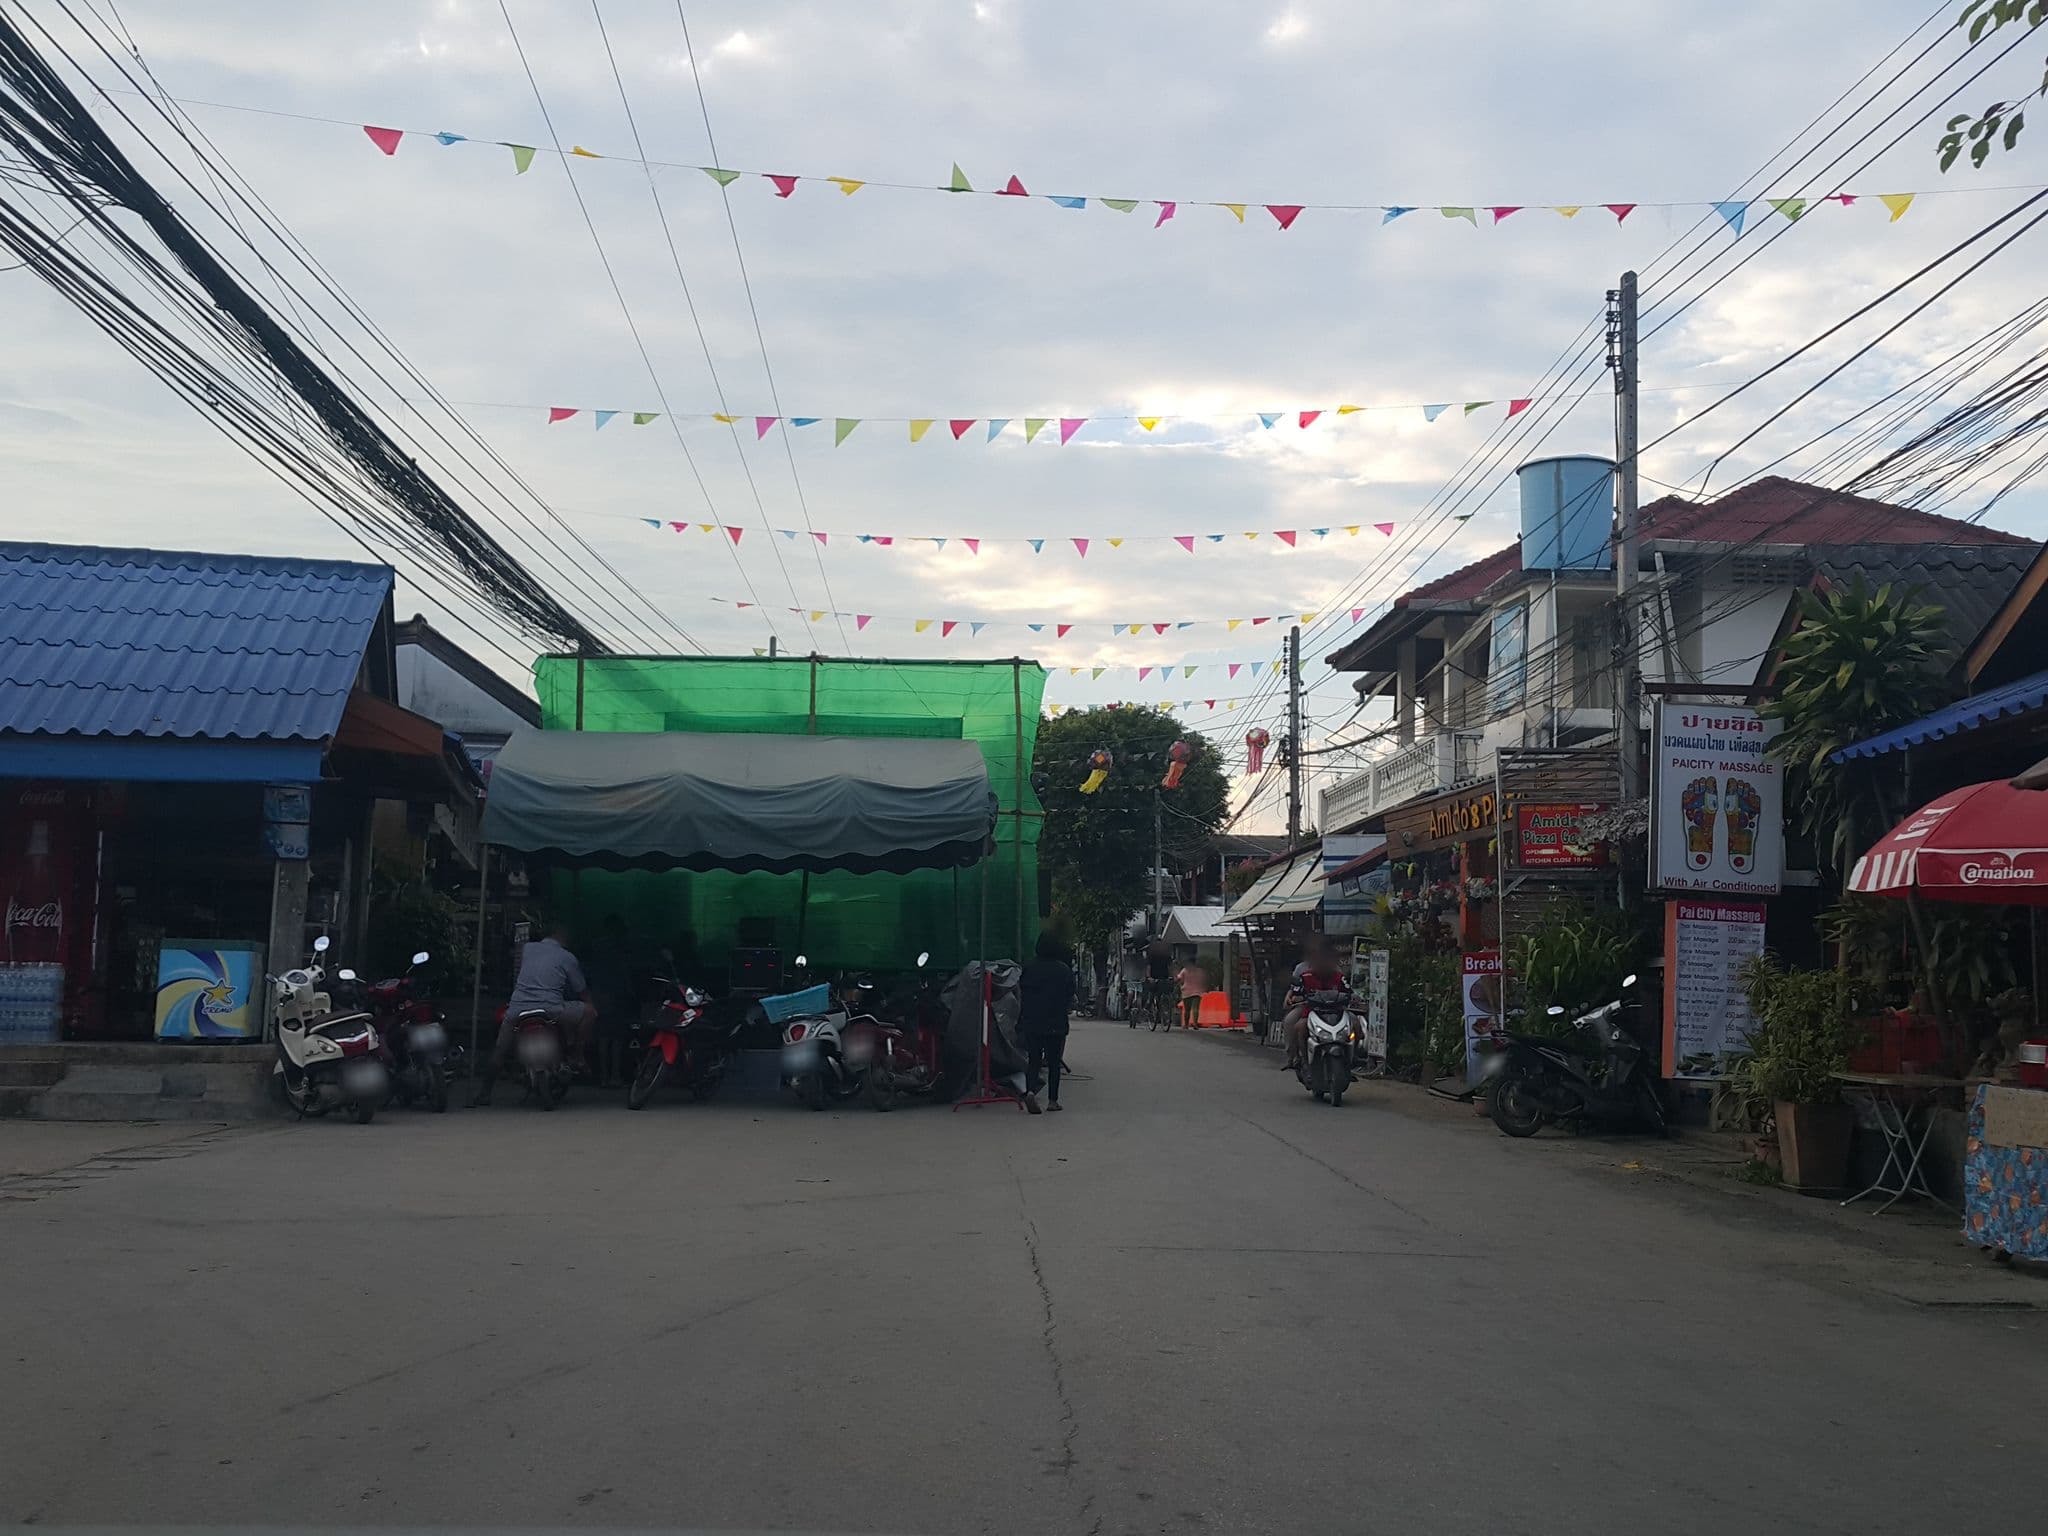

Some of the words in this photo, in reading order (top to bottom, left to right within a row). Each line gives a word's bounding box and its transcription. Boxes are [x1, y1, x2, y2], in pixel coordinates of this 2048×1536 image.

[1672, 758, 1714, 770] PAICITY
[1719, 761, 1774, 775] MASSAGE
[1522, 830, 1556, 844] Pizza
[1959, 862, 2035, 883] Carnation
[1664, 876, 1688, 889] With
[1692, 878, 1707, 888] Air
[1712, 879, 1777, 893] Conditioned
[1696, 906, 1716, 921] City
[1717, 908, 1761, 922] Massage
